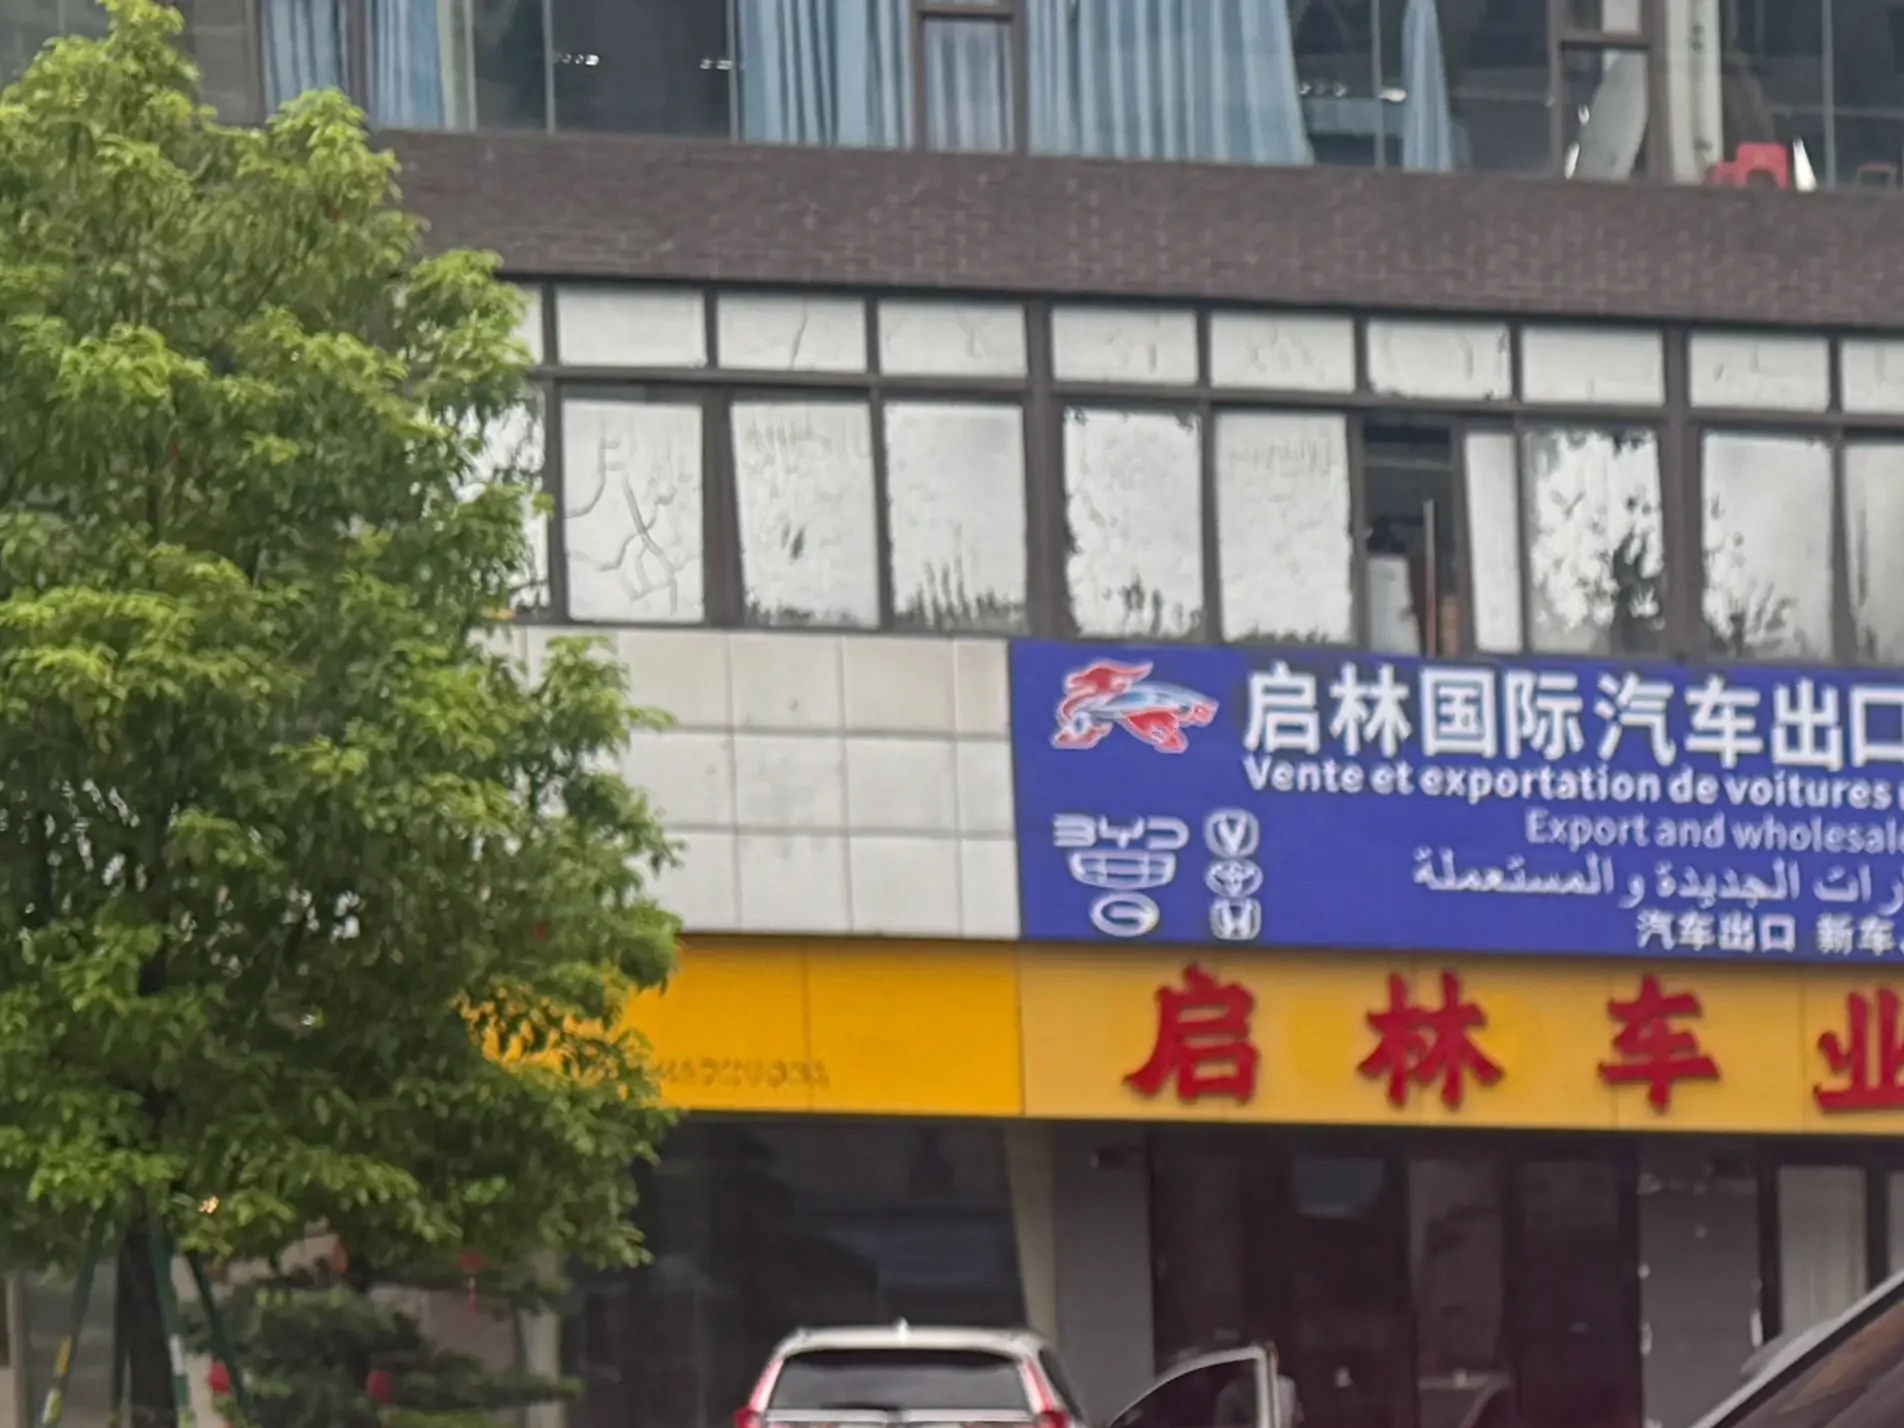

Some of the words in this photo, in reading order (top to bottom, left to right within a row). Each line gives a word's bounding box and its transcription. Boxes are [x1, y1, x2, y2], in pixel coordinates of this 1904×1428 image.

[1243, 753, 1364, 793] Vente
[1371, 760, 1414, 795] et
[1420, 762, 1660, 805] exportation
[1668, 765, 1718, 804] de
[1725, 769, 1892, 810] voitures
[1526, 808, 1648, 852] Export
[1656, 812, 1724, 849] and
[1637, 909, 1796, 953] 汽车出口
